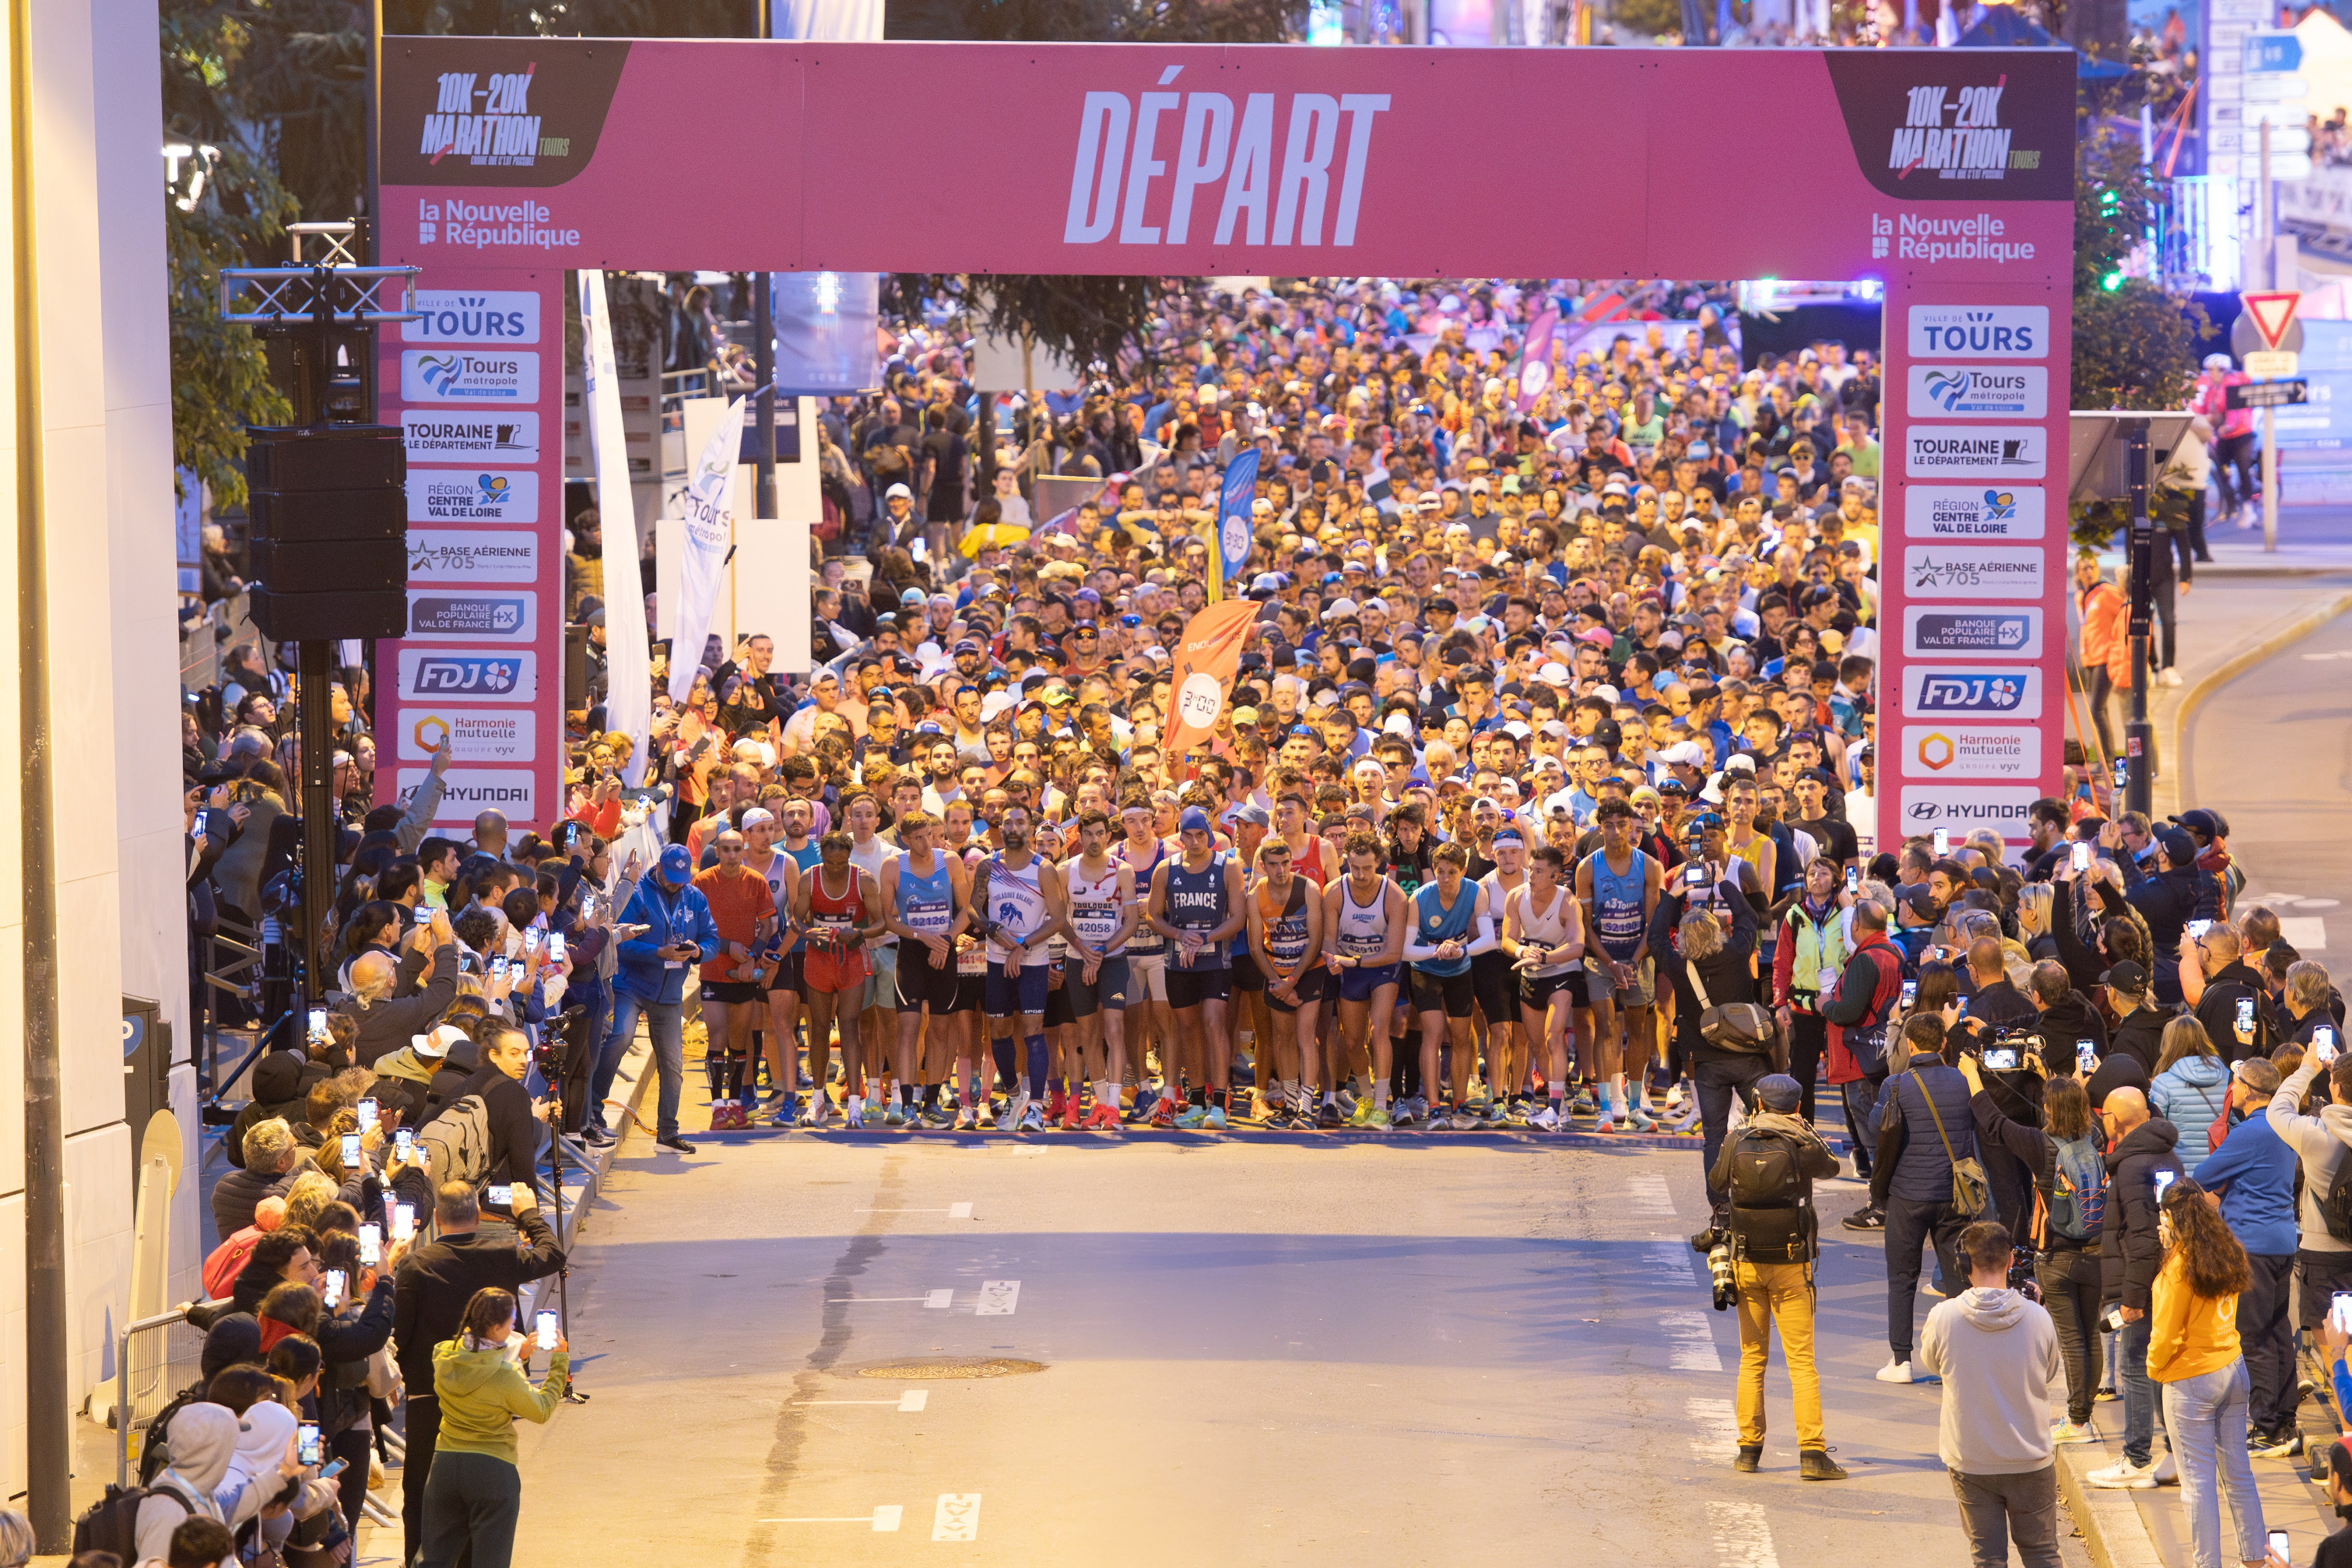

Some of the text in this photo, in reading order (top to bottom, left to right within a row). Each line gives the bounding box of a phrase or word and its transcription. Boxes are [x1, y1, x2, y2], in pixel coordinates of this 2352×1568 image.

[436, 73, 533, 114] 10K-20K
[1906, 86, 2003, 127] 10K-20K
[420, 114, 541, 155] MARATHON
[538, 137, 570, 157] TOURS
[1889, 128, 2012, 169] MARATHON
[1063, 65, 1392, 246] DÉPART
[2008, 150, 2040, 169] TOURS
[420, 198, 550, 222] la Nouvelle
[1873, 213, 2004, 236] la Nouvelle
[446, 220, 580, 249] République
[1899, 235, 2035, 263] République
[416, 311, 525, 337] TOURS
[1924, 326, 2033, 351] TOURS
[462, 357, 518, 374] Tours
[464, 377, 518, 386] métropole
[1969, 372, 2025, 389] Tours
[1971, 392, 2025, 401] métropole
[408, 424, 493, 438] TOURAINE
[409, 438, 492, 450] LE DÉPARTEMENT
[1914, 439, 1999, 454] TOURAINE
[1914, 454, 1999, 465] LE DÉPARTEMENT
[428, 482, 473, 495] RÉGION
[428, 496, 473, 506] CENTRE
[1933, 498, 1979, 511] RÉGION
[428, 507, 502, 517] VAL DE LOIRE
[1933, 512, 1979, 522] CENTRE
[1933, 523, 2008, 533] VAL DE LOIRE
[440, 545, 531, 557] BASE AÉRIENNE
[440, 556, 475, 569] 705
[1946, 561, 2037, 572] BASE AÉRIENNE
[1945, 571, 1980, 585] 705
[450, 604, 491, 612] BANQUE
[436, 611, 491, 620] POPULAIRE
[419, 620, 436, 628] VAL
[1955, 620, 1996, 628] BANQUE
[1941, 627, 1996, 635] POPULAIRE
[1923, 636, 1996, 645] VAL DE FRANCE
[421, 663, 481, 688] FDJ
[1924, 680, 1986, 705] FDJ
[455, 717, 516, 729] Harmonie
[455, 729, 516, 738] mutuelle
[1959, 734, 2021, 744] Harmonie
[1960, 745, 2021, 755] mutuelle
[443, 788, 528, 801] HYUNDAI
[1947, 805, 2027, 818] HYUNDA
[1174, 892, 1217, 911] FRANCE
[909, 915, 946, 926] 52126
[1078, 923, 1111, 933] 42058
[1348, 945, 1381, 954] 42910
